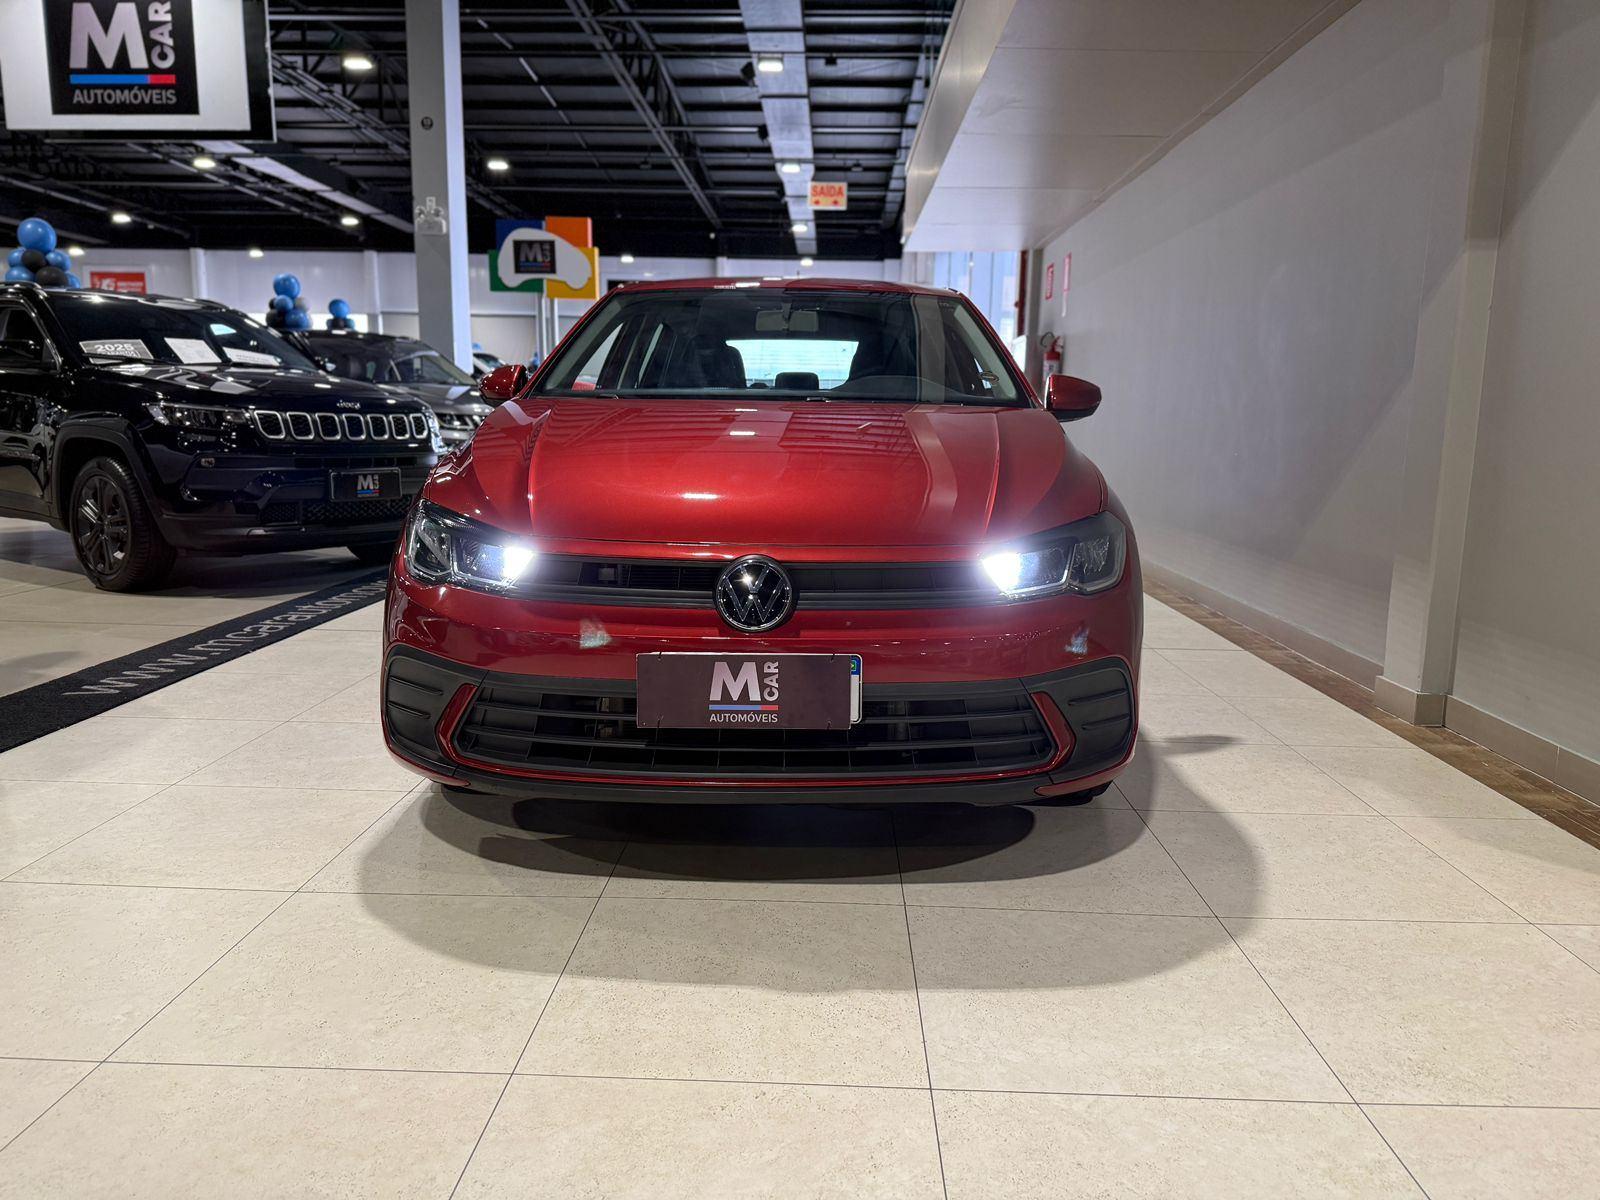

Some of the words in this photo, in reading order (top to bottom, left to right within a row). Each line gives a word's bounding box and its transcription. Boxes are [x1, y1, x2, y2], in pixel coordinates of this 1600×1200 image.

[69, 2, 149, 69] M
[147, 0, 176, 69] CAR
[73, 86, 177, 105] AUTOMÓVEIS
[94, 343, 134, 352] 2025
[709, 661, 762, 701] M
[763, 661, 779, 702] CAR
[709, 711, 778, 724] AUTOMÓVEIS
